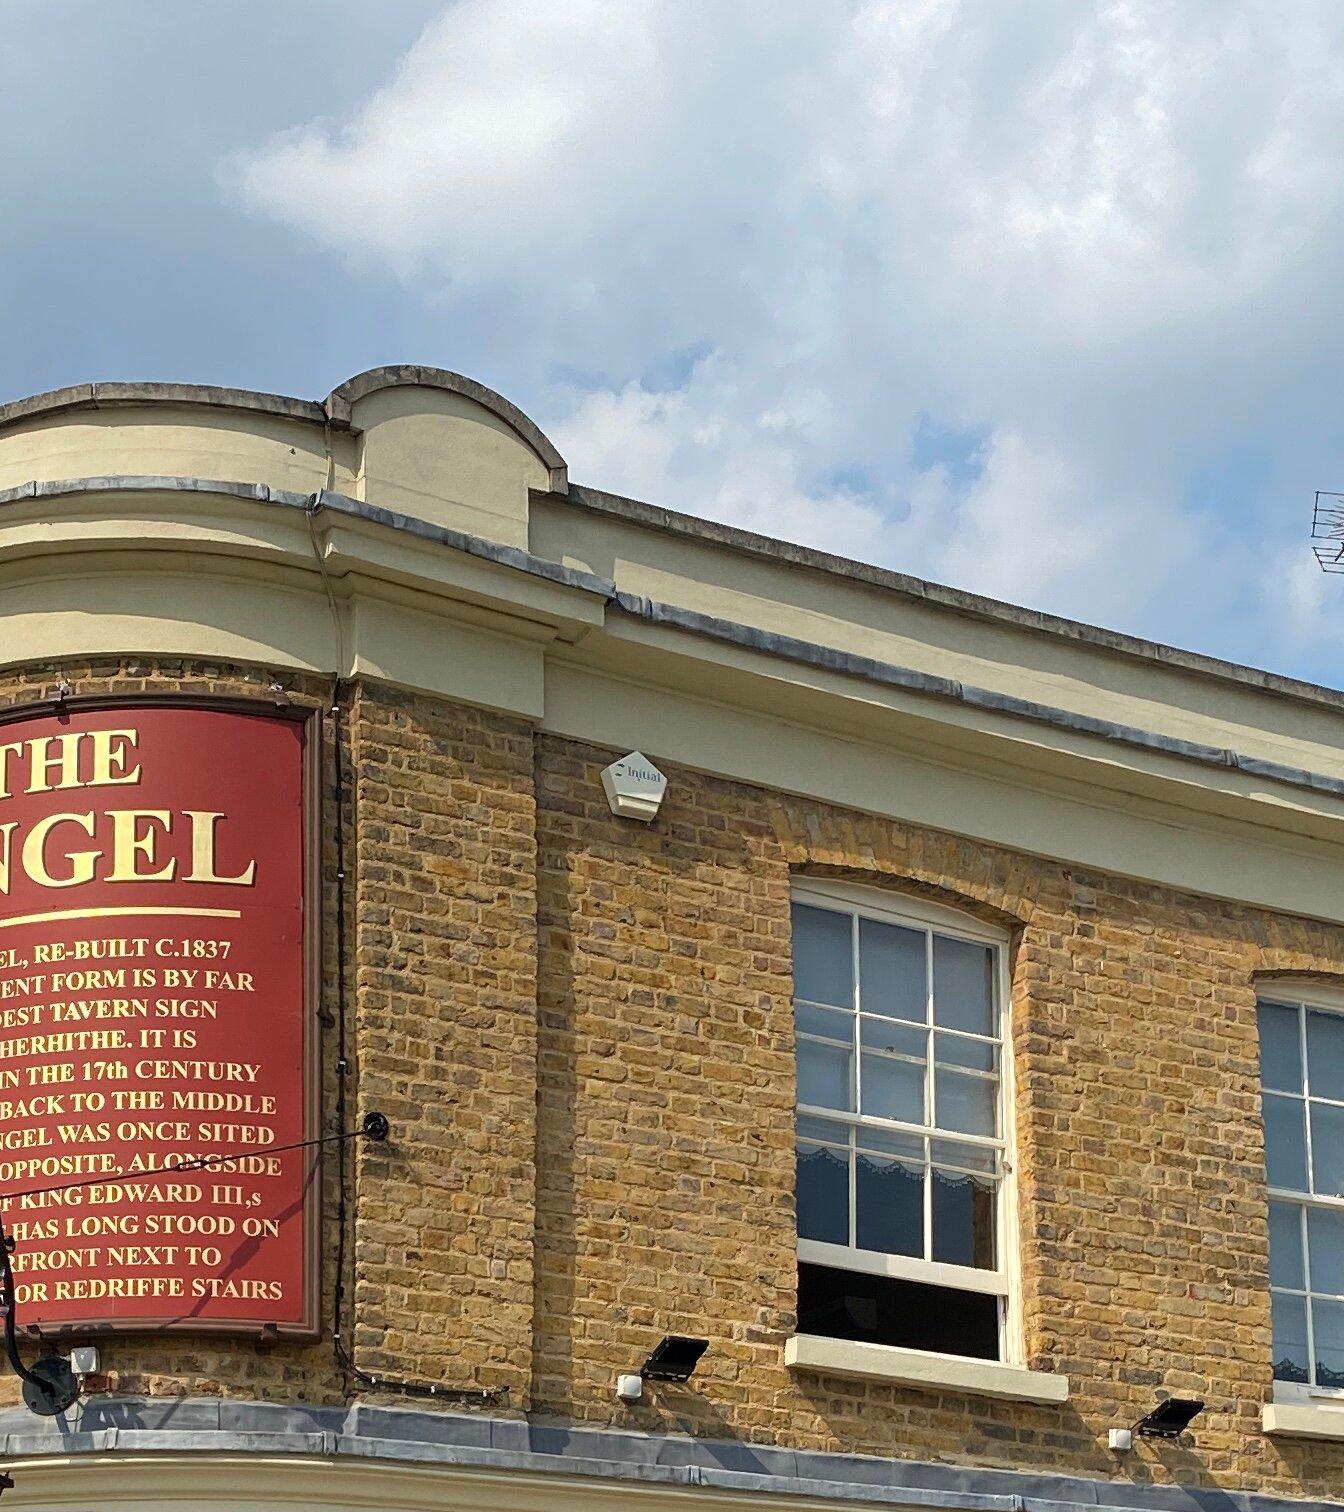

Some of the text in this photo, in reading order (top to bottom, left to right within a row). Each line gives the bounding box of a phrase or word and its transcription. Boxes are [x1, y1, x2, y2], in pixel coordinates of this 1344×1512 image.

[627, 765, 661, 782] Initial
[33, 938, 150, 964] RE-BUILT
[155, 938, 232, 960] C.1837
[51, 969, 127, 993] FORM
[132, 968, 157, 988] IS
[163, 969, 199, 988] BY
[204, 970, 256, 992] FAR
[49, 998, 148, 1022] TAVERN
[155, 998, 218, 1020] SIGN
[139, 1029, 167, 1049] IT
[172, 1029, 197, 1049] IS
[25, 1063, 75, 1087] THE
[82, 1060, 129, 1082] 17th
[134, 1060, 262, 1083] CENTURY
[0, 1094, 66, 1121] BACK
[69, 1092, 106, 1113] TO
[111, 1091, 165, 1111] THE
[171, 1091, 278, 1115] MIDDLE
[56, 1122, 111, 1144] WAS
[116, 1121, 192, 1142] ONCE
[198, 1122, 276, 1145] SITED
[128, 1152, 283, 1177] ALONGSIDE
[19, 1185, 83, 1211] KING
[88, 1183, 203, 1205] EDWARD
[12, 1219, 59, 1243] HAS
[65, 1215, 140, 1238] LONG
[145, 1214, 236, 1236] STOOD
[242, 1217, 280, 1238] ON
[106, 1246, 179, 1267] NEXT
[184, 1246, 222, 1267] TO
[14, 1282, 49, 1305] OR
[54, 1277, 184, 1301] REDRIFFE
[191, 1278, 283, 1301] STAIRS
